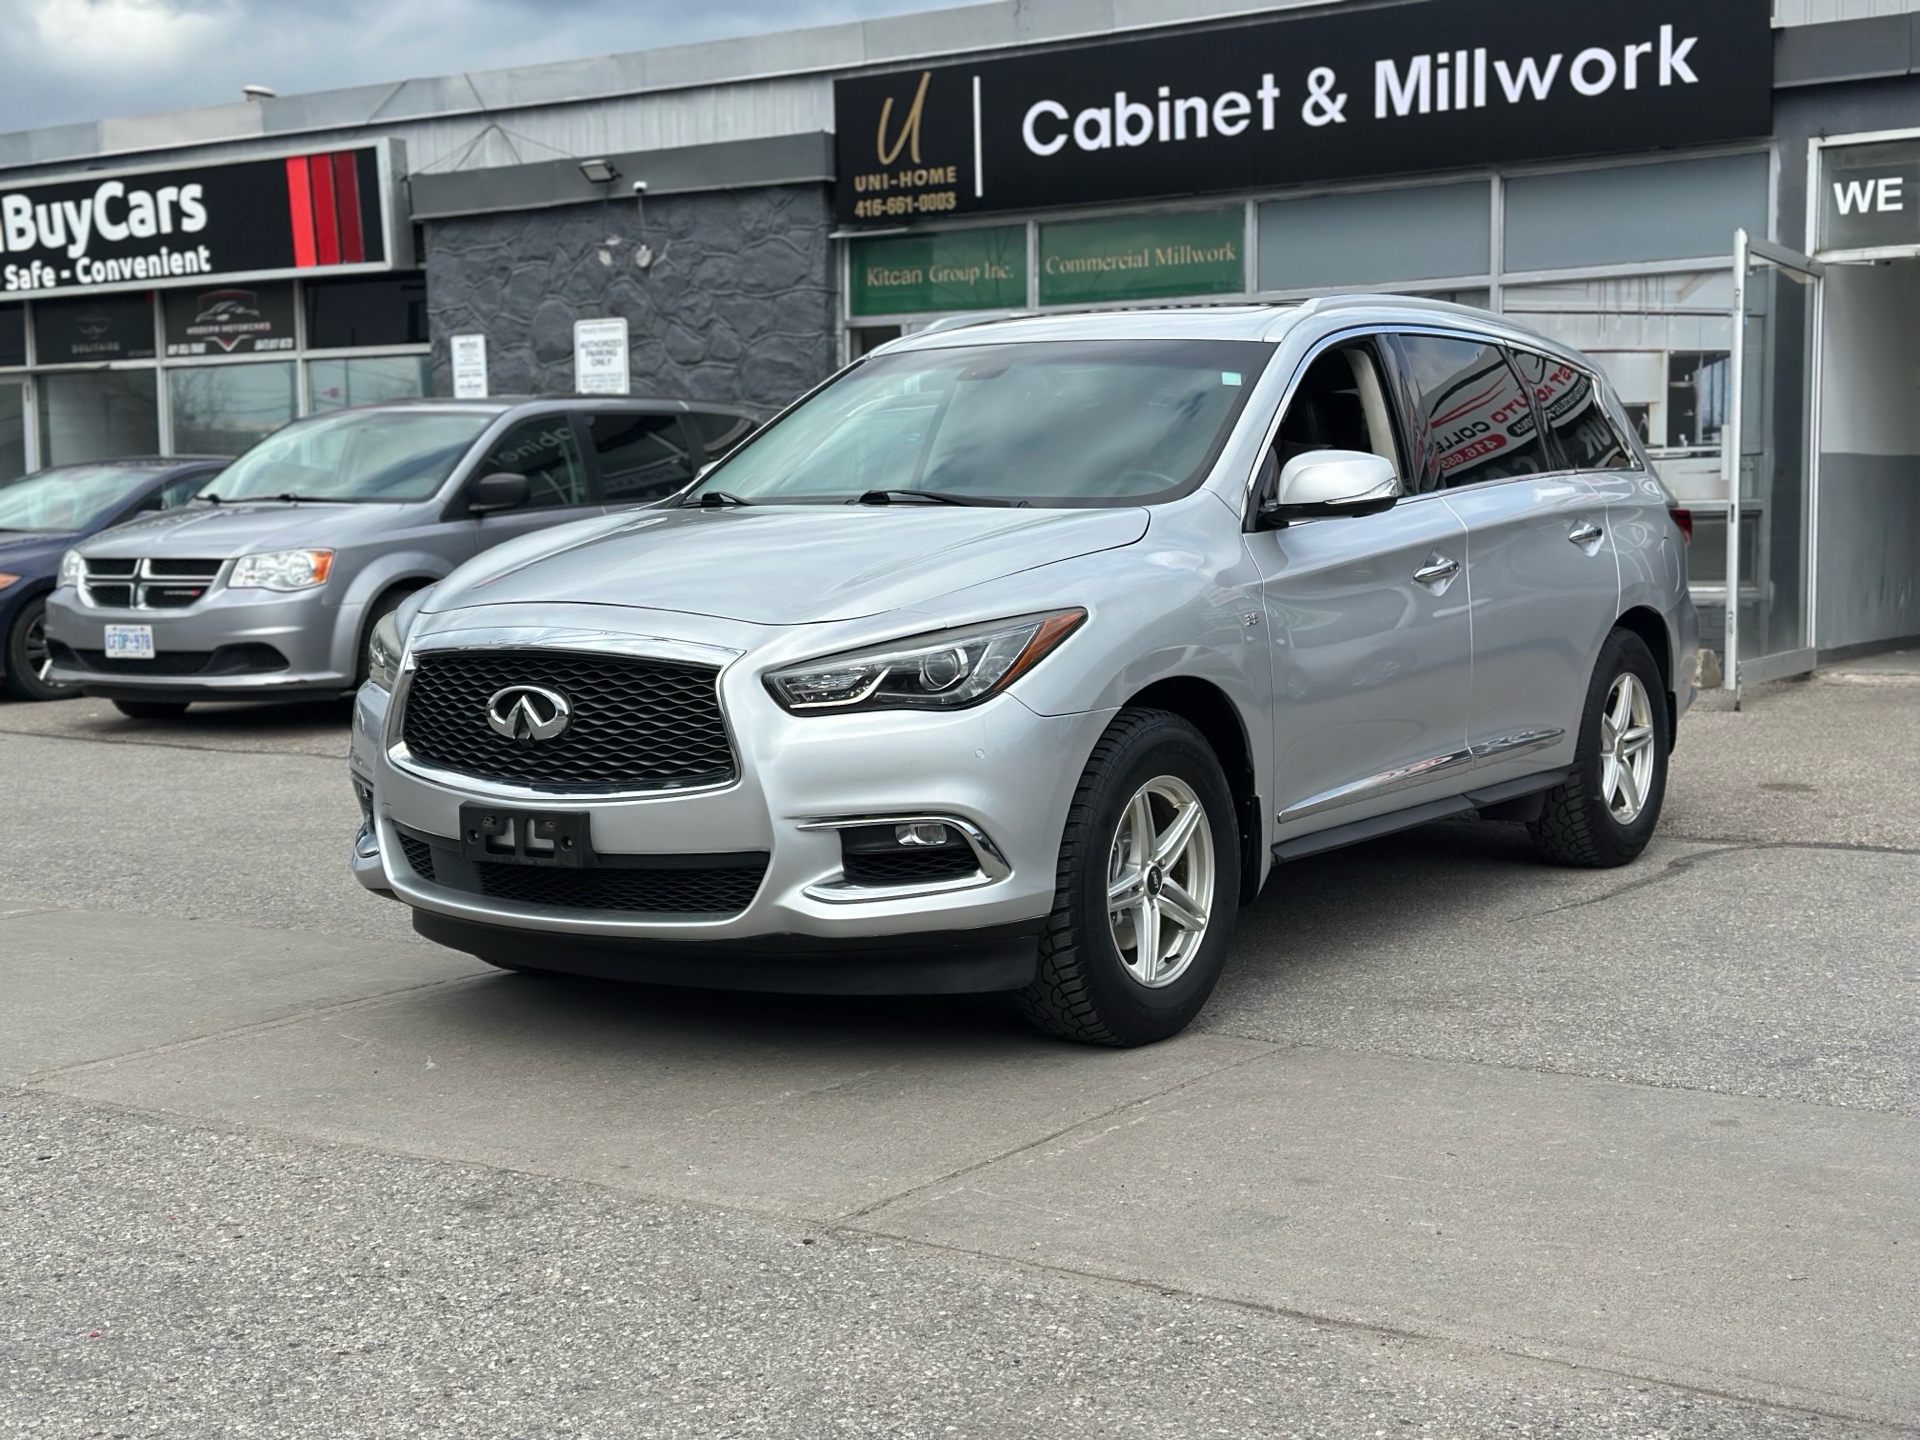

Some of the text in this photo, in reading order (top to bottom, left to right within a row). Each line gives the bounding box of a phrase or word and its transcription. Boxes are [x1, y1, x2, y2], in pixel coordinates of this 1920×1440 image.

[1022, 24, 1699, 156] Cabinet & Millwork
[854, 166, 957, 192] UNI-HOME
[1833, 177, 1903, 215] WE
[0, 180, 208, 259] BuyCars
[4, 259, 56, 291] Safe
[75, 245, 212, 284] Convenient
[867, 261, 1014, 286] Kitcan Group Inc.
[1045, 241, 1236, 275] Commercial Millwork
[586, 349, 617, 358] PARKING
[591, 358, 612, 367] ONLY
